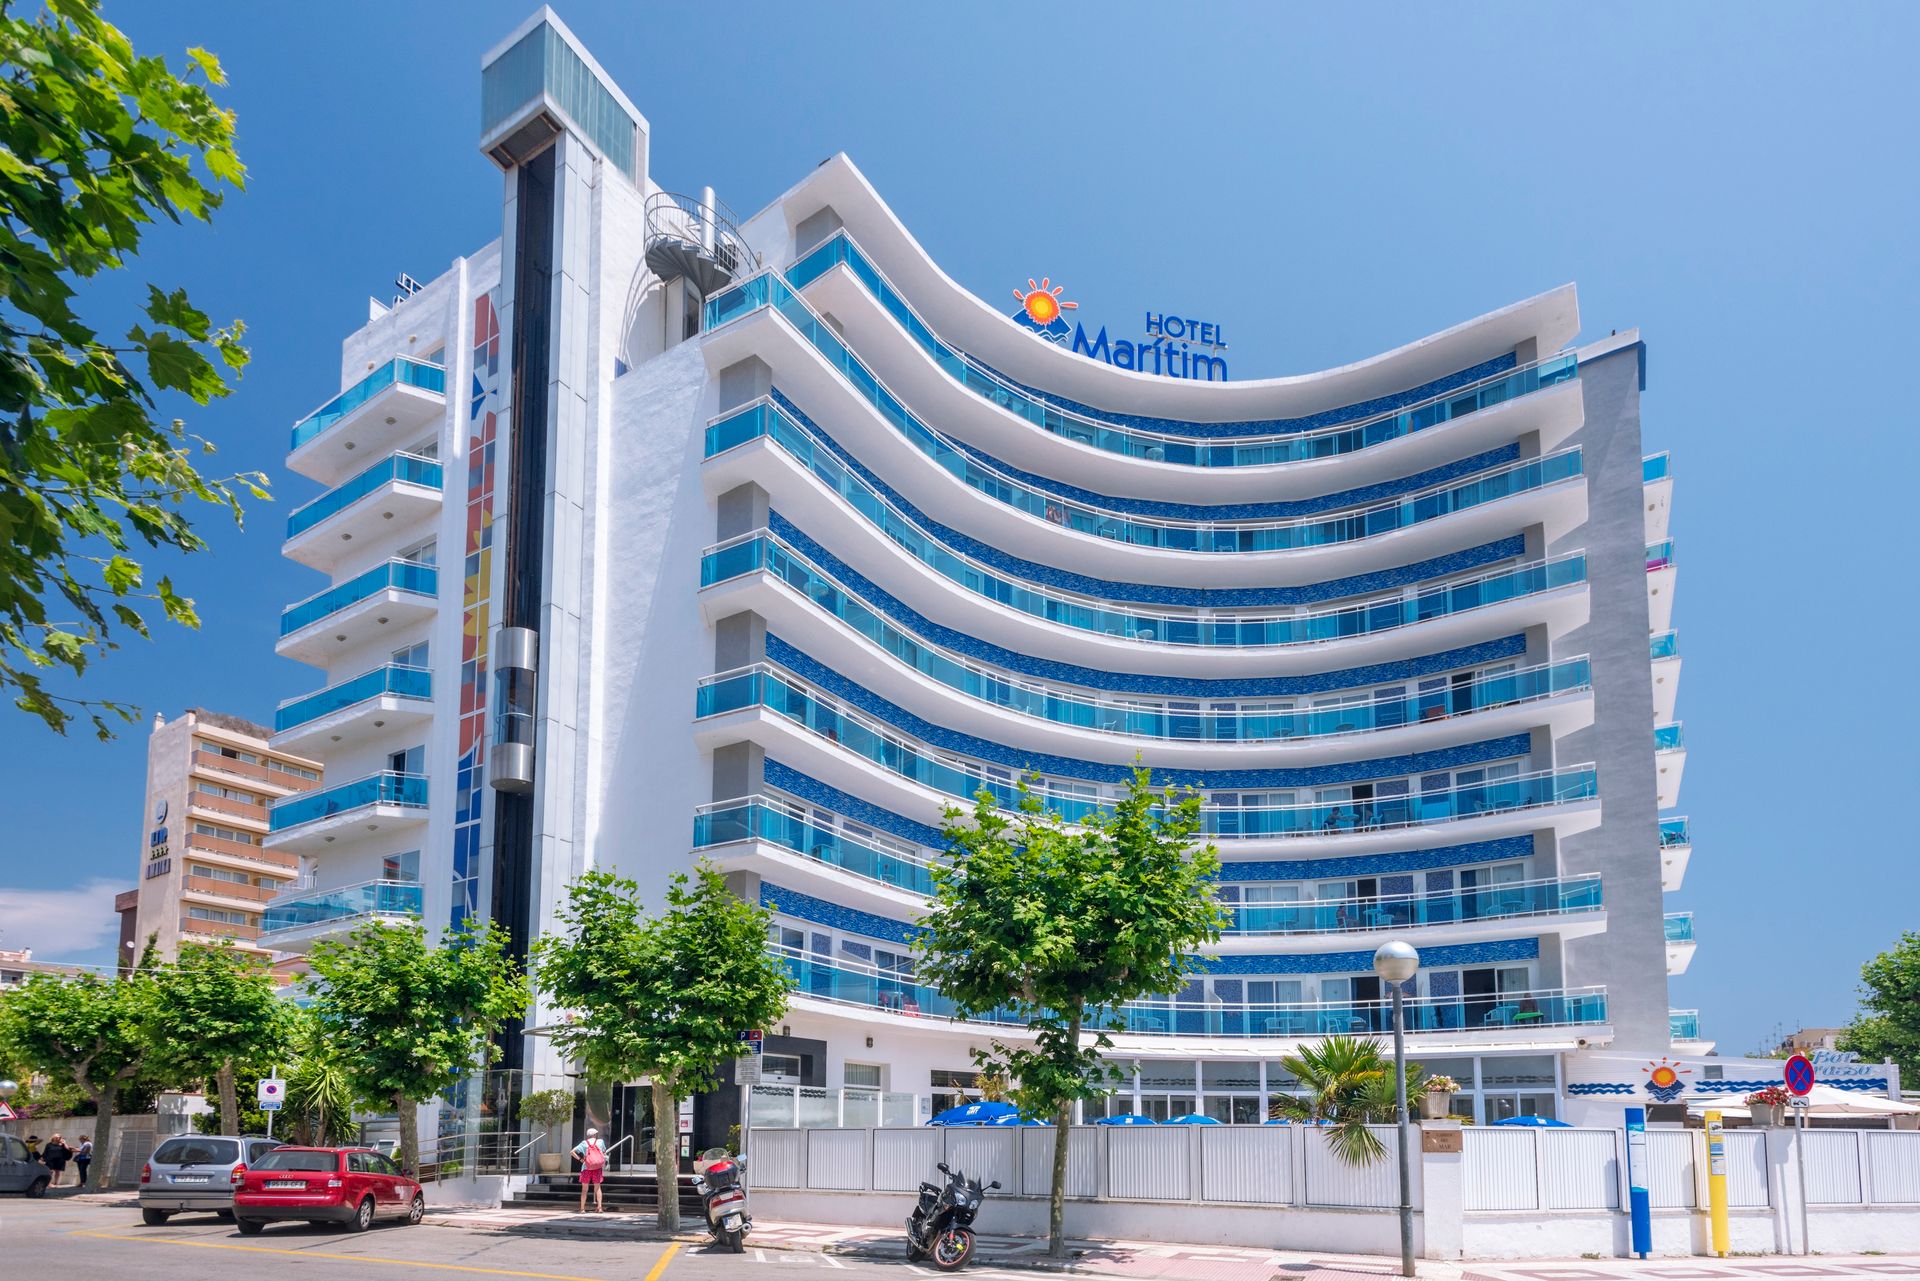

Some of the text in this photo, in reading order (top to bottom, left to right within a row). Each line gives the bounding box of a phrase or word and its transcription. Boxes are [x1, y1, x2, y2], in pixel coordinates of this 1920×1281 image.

[1146, 312, 1227, 348] HOTEL
[1072, 321, 1228, 382] Marítim
[1812, 1050, 1858, 1065] Bar
